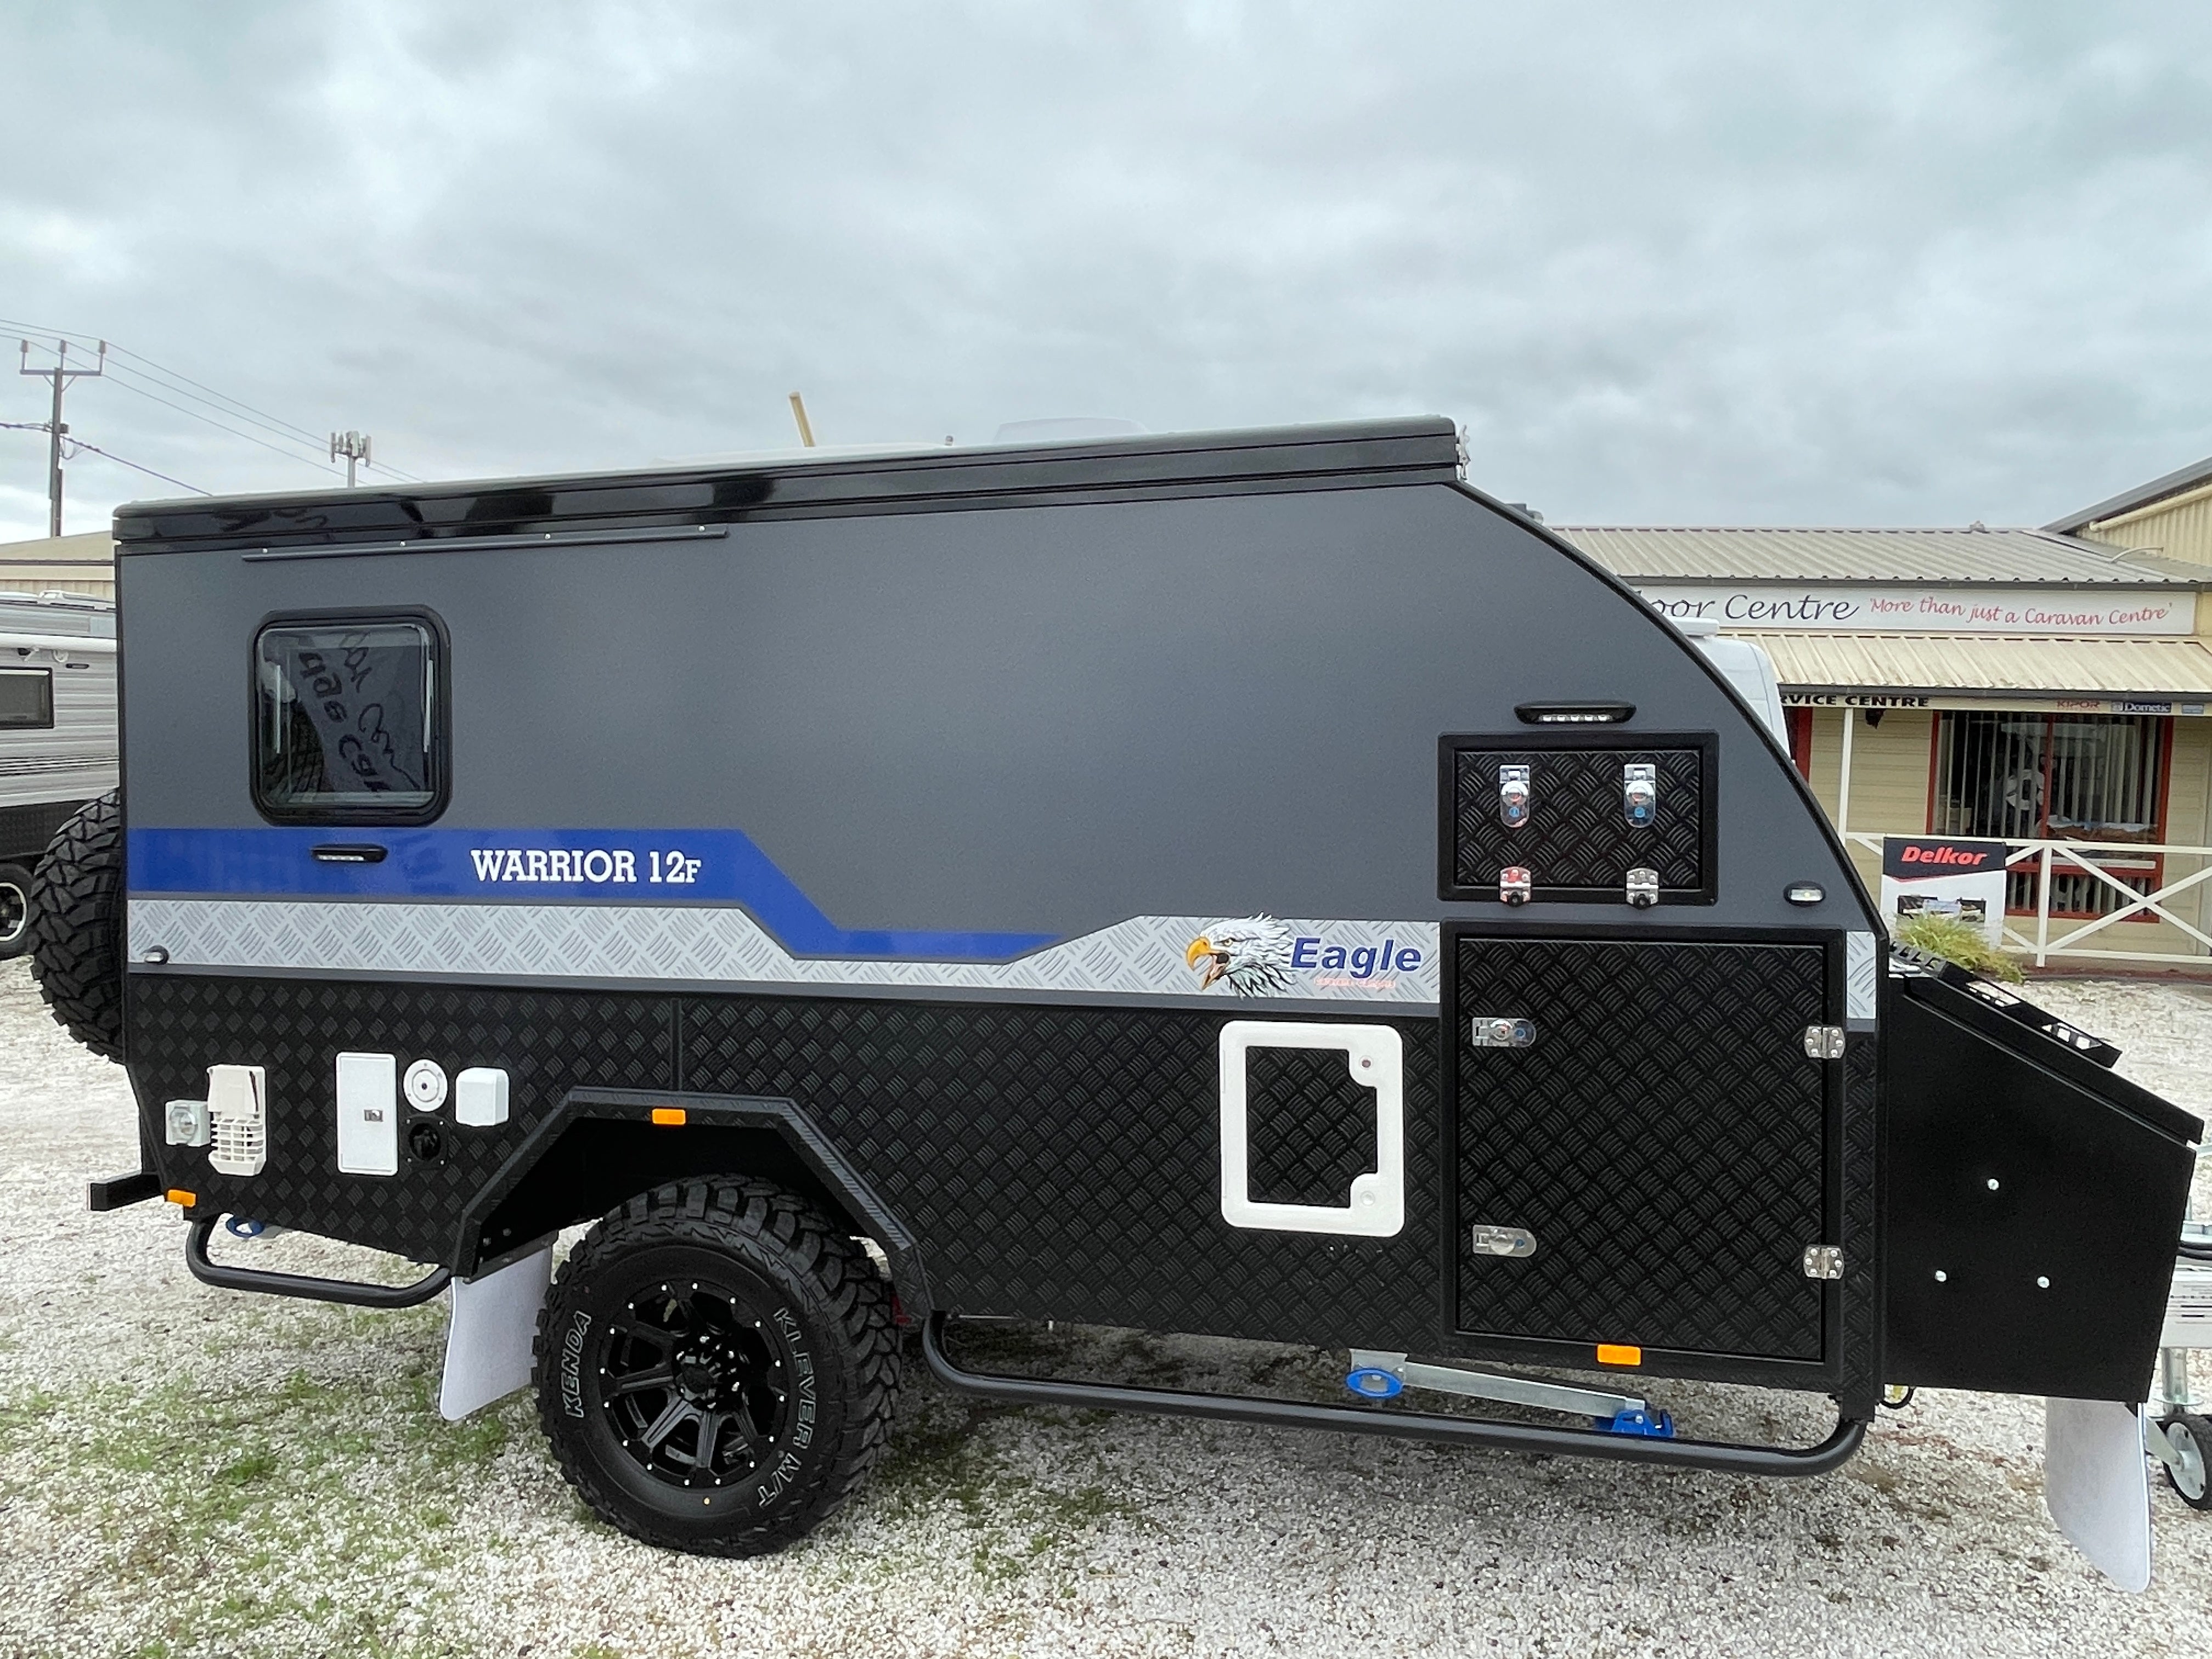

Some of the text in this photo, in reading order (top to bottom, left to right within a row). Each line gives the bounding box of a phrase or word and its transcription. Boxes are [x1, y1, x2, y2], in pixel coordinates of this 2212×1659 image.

[1637, 591, 1860, 620] oor Centre
[1920, 596, 1966, 616] than
[1966, 604, 2003, 623] just
[2005, 611, 2020, 623] a
[2025, 608, 2104, 625] Caravan
[1845, 695, 1929, 707] CENTRE
[471, 850, 638, 882] WARRIOR
[1901, 845, 1989, 866] Delkor
[1289, 936, 1422, 979] Eagle
[561, 1310, 592, 1418] KENDA
[758, 1307, 816, 1507] KLEVER M/T
